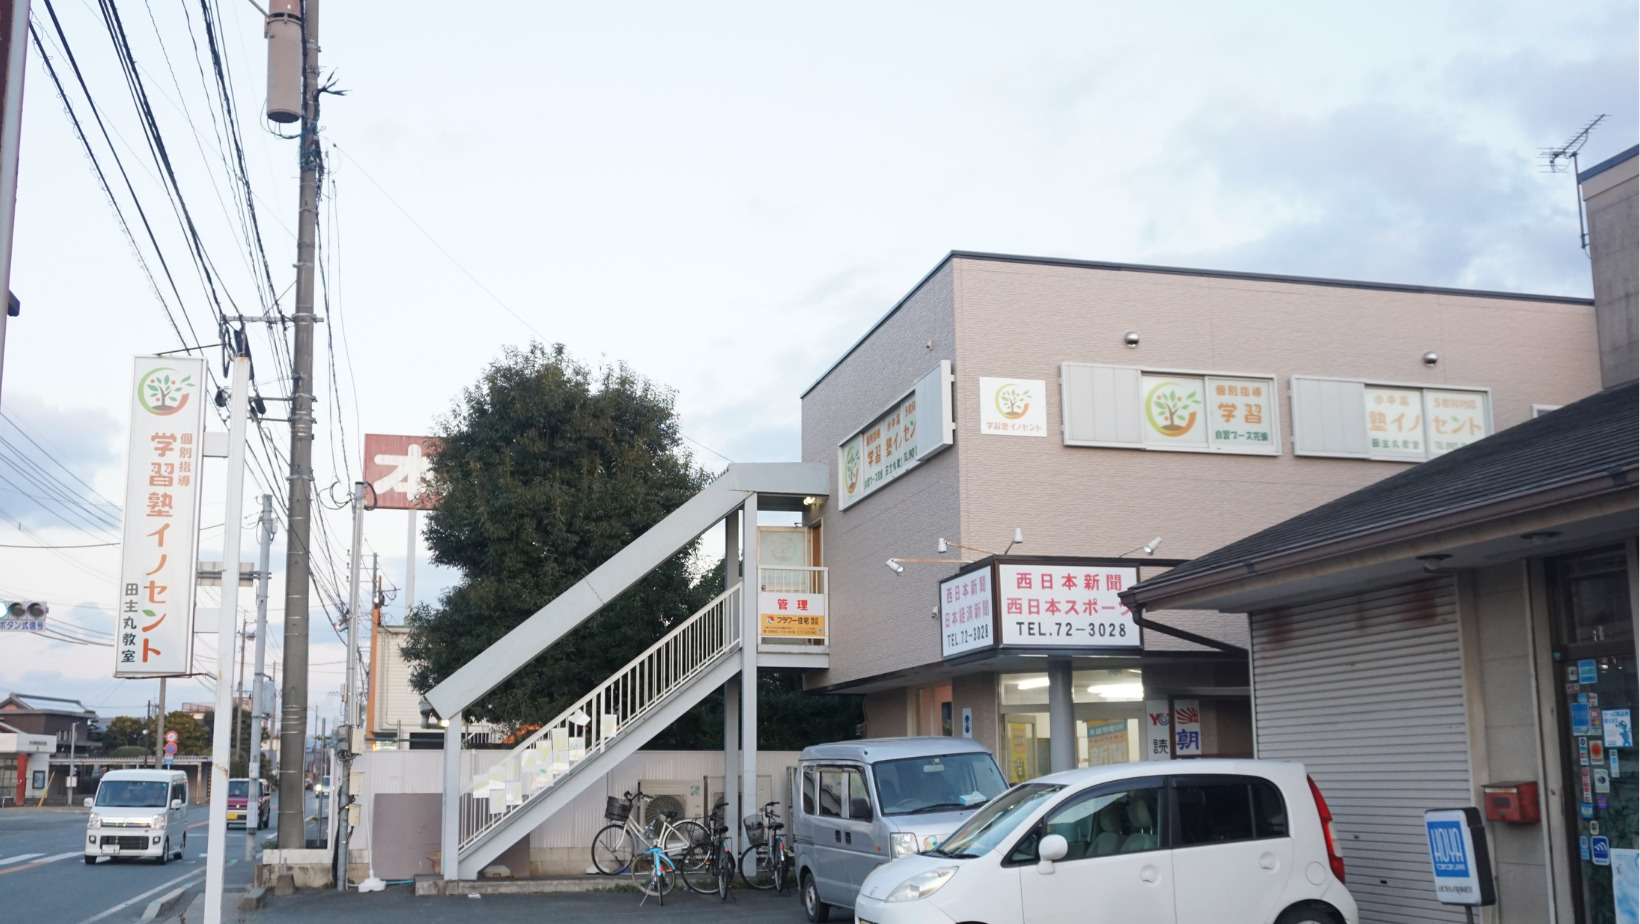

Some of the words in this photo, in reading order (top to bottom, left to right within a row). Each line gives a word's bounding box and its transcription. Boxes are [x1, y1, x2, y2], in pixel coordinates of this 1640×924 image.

[1215, 384, 1262, 398] 個別指導
[1374, 394, 1409, 407] 小中高
[1217, 401, 1263, 425] 学習
[985, 421, 1043, 432] 学習塾イノセント
[1371, 438, 1420, 449] 田主丸教室
[178, 432, 193, 487] 個別指導
[141, 431, 177, 664] 学習塾イノセント
[946, 575, 987, 604] 西日本新聞
[1016, 572, 1123, 592] 西日本新聞
[777, 598, 809, 611] 管理
[944, 598, 990, 629] 日本経済新聞
[120, 582, 139, 664] 田主丸教室
[776, 616, 810, 625] フラワー住宅
[1153, 738, 1169, 754] 読
[1176, 728, 1200, 751] 朝
[1430, 828, 1464, 863] HOYA
